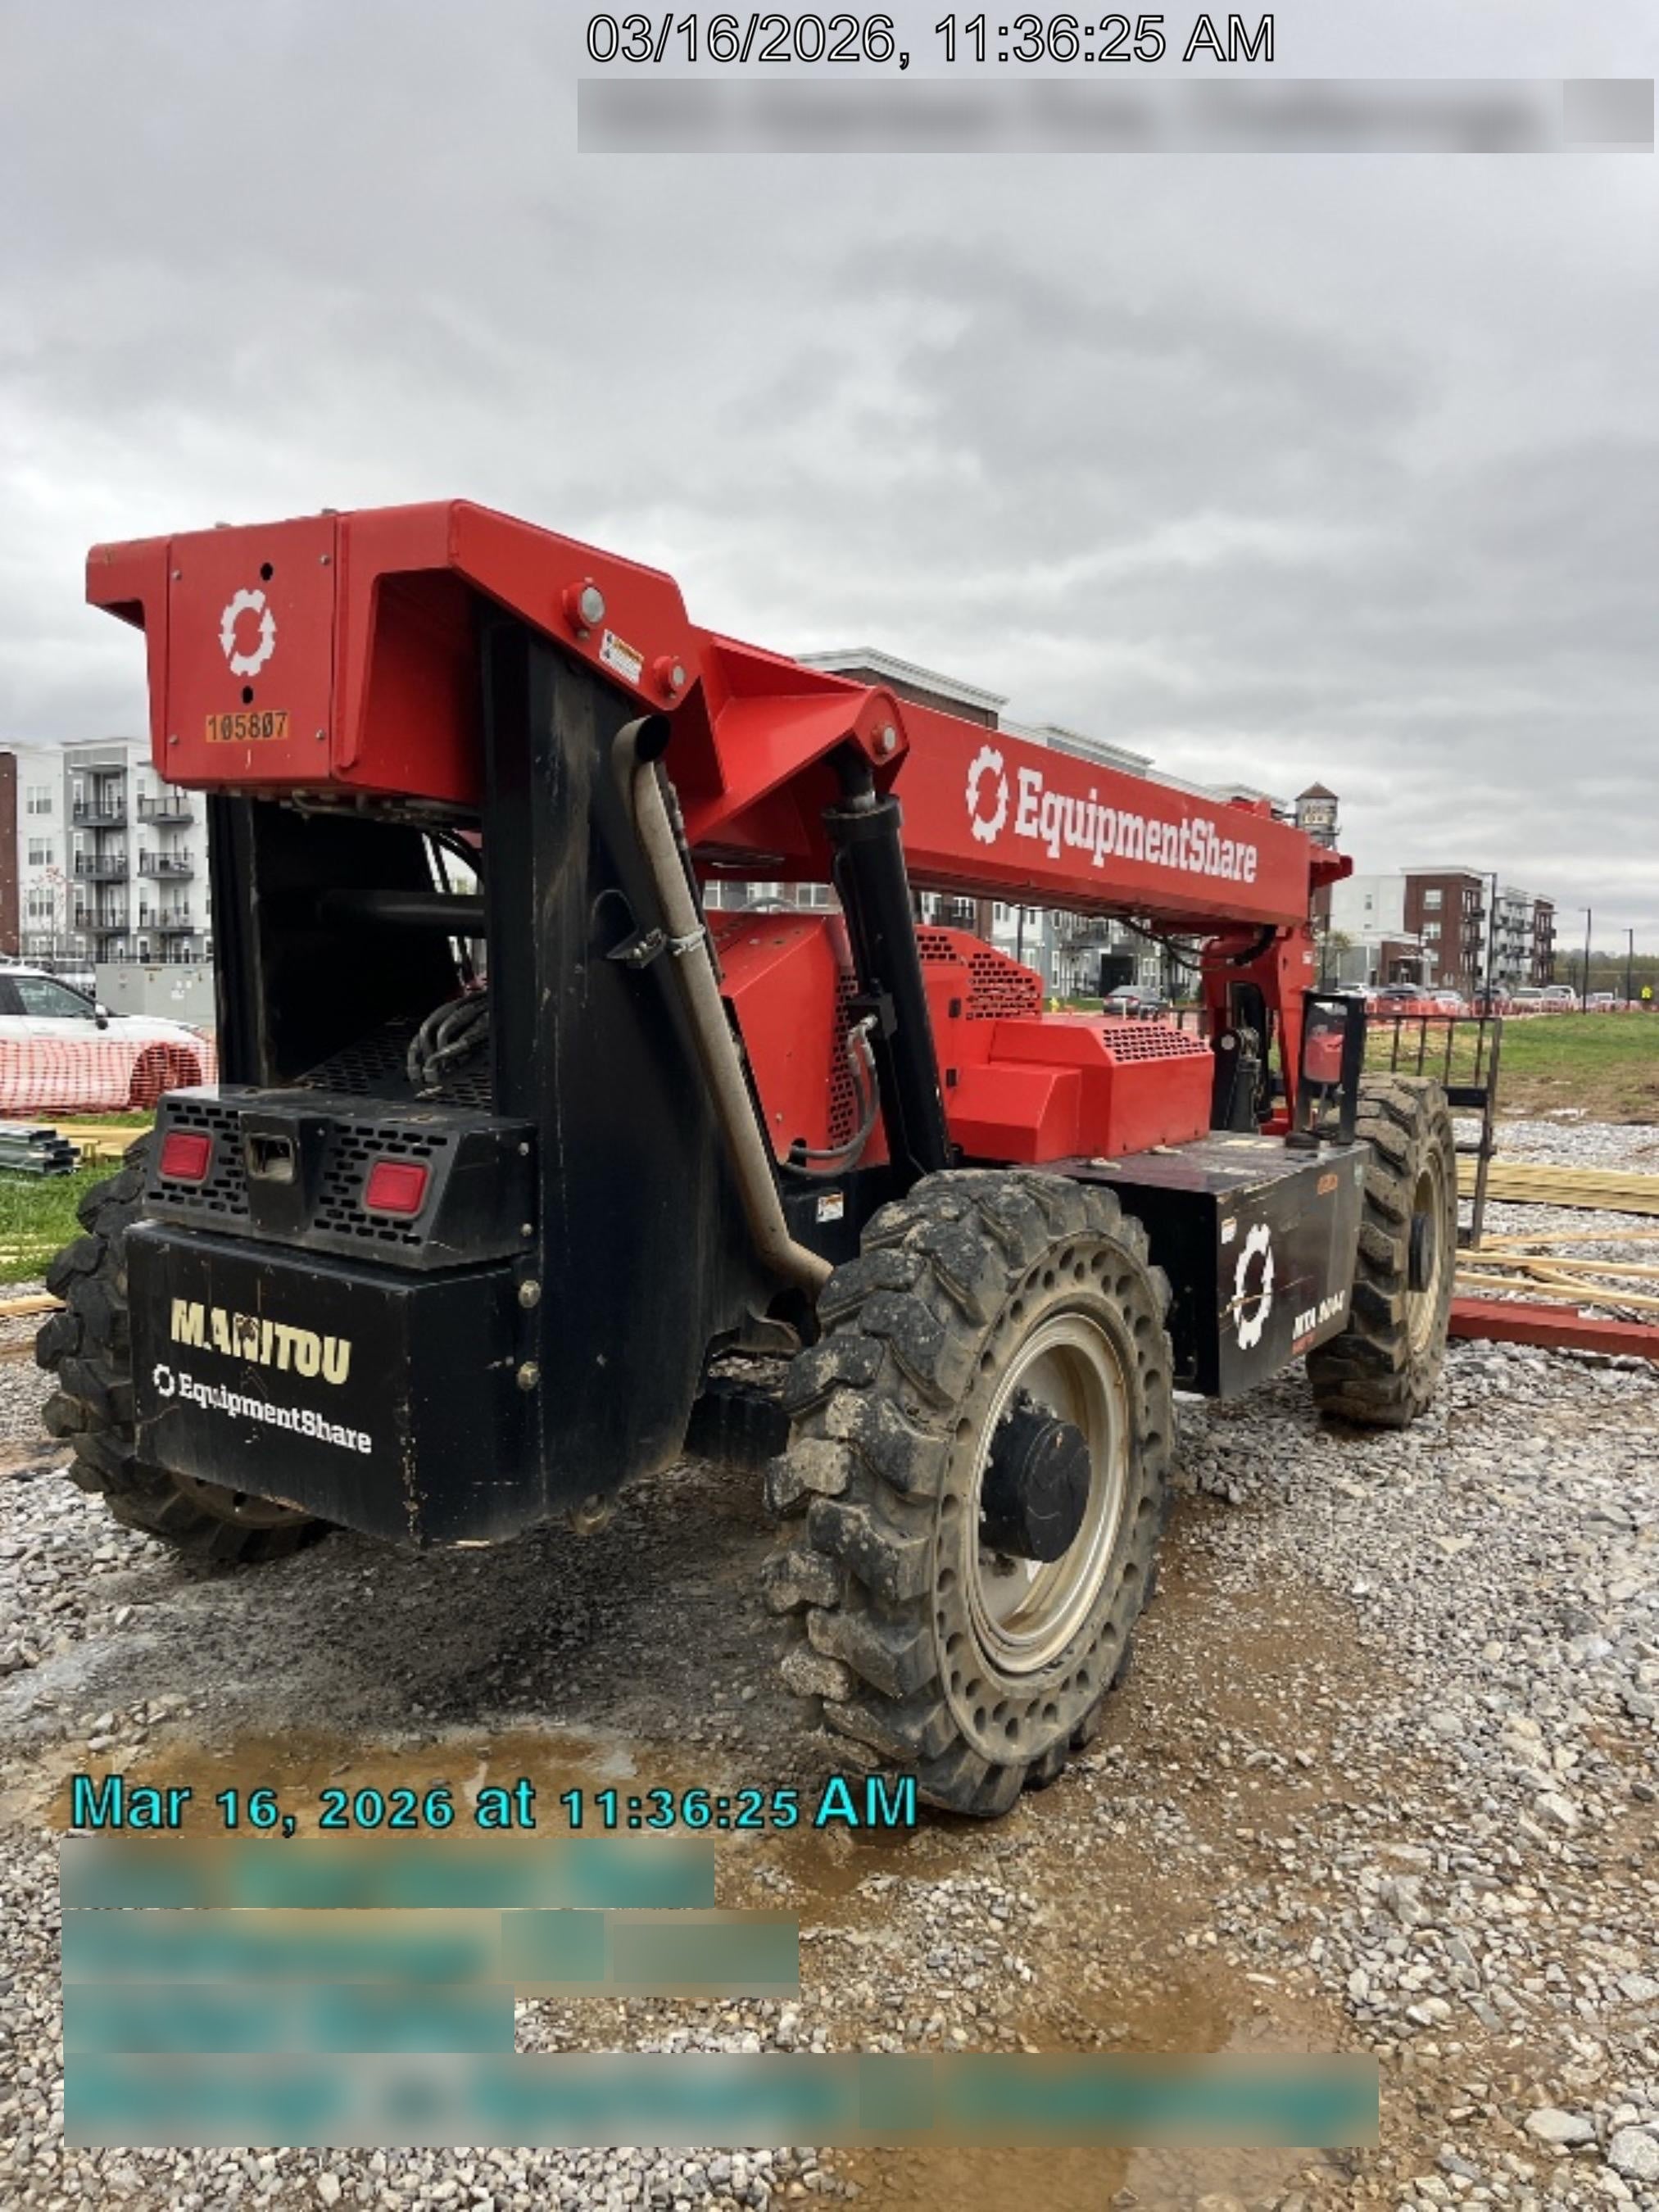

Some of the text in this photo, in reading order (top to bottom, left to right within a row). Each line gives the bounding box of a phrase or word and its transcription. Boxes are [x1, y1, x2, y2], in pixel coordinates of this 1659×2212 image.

[208, 711, 288, 741] 105807
[1014, 766, 1258, 883] EquipmentShare
[170, 1298, 351, 1385] MANITOU
[178, 1371, 372, 1454] EquipmentShare
